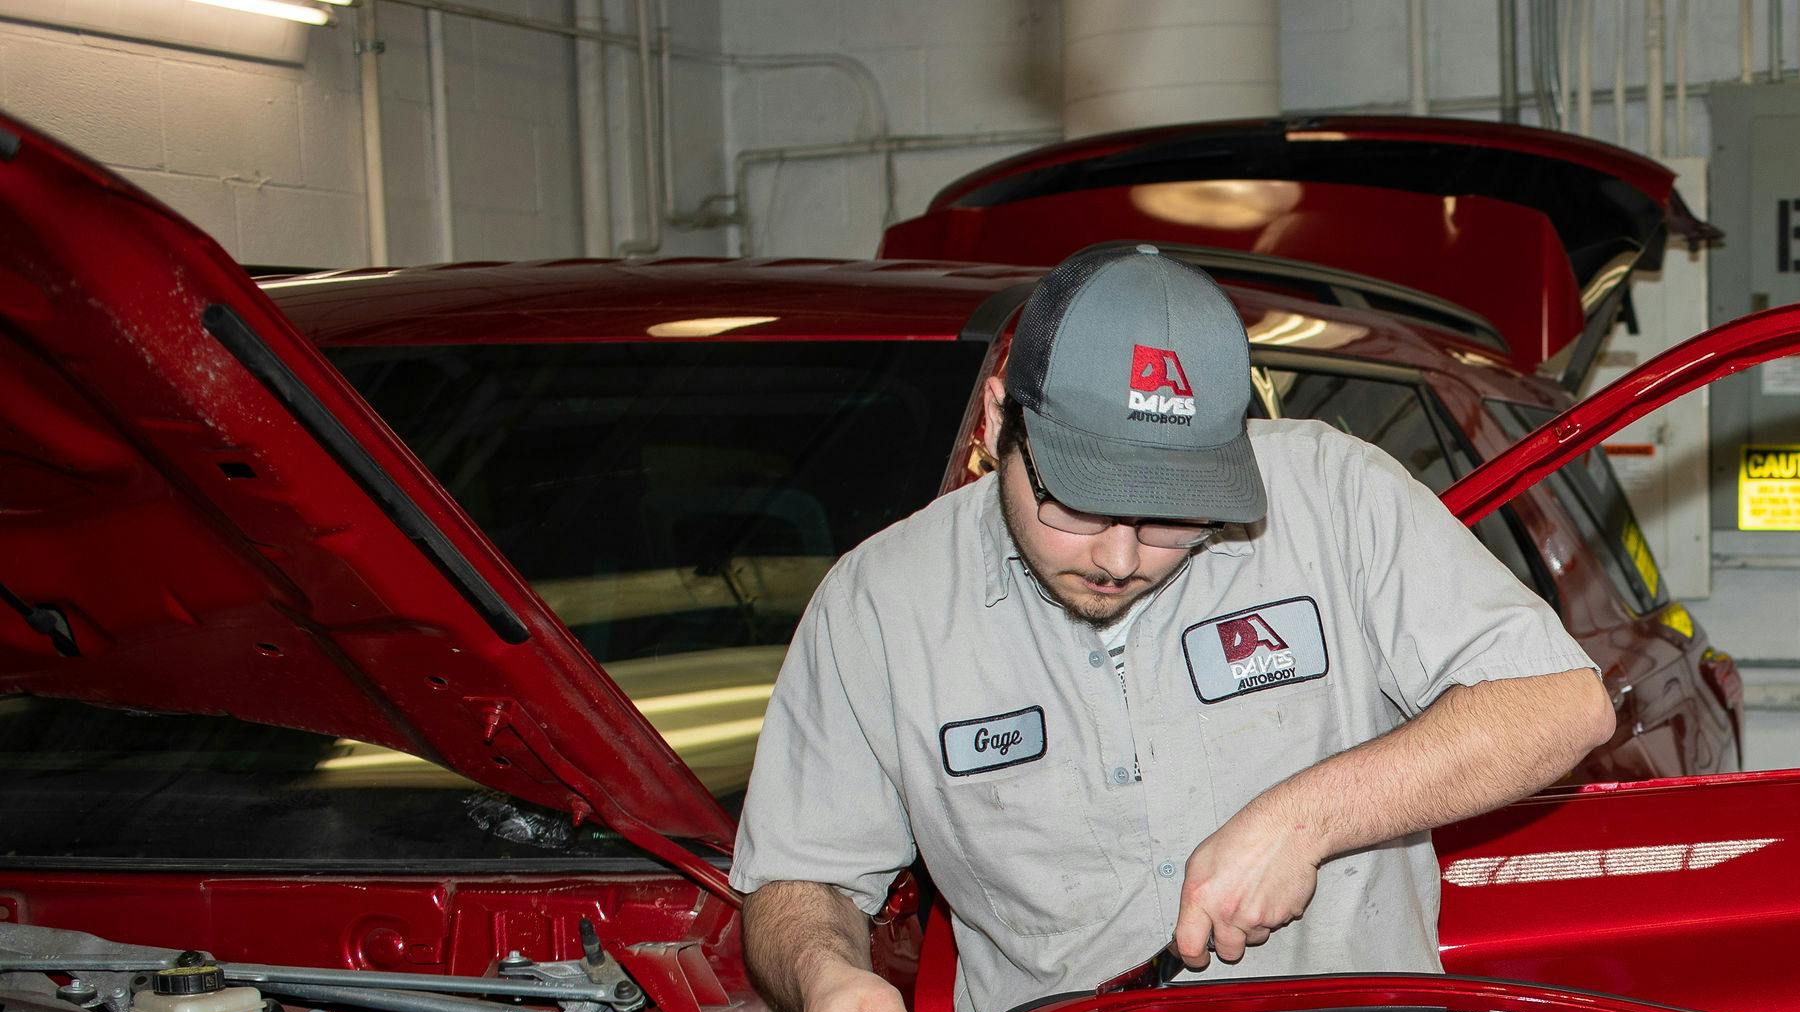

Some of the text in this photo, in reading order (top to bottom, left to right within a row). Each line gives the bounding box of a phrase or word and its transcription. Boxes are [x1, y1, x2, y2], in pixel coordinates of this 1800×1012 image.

[1128, 390, 1197, 416] DAVES
[1127, 410, 1193, 427] AUTOBODY
[1230, 650, 1297, 680] DAVES
[1237, 667, 1297, 691] AUTOBODY
[974, 727, 1023, 756] Gage
